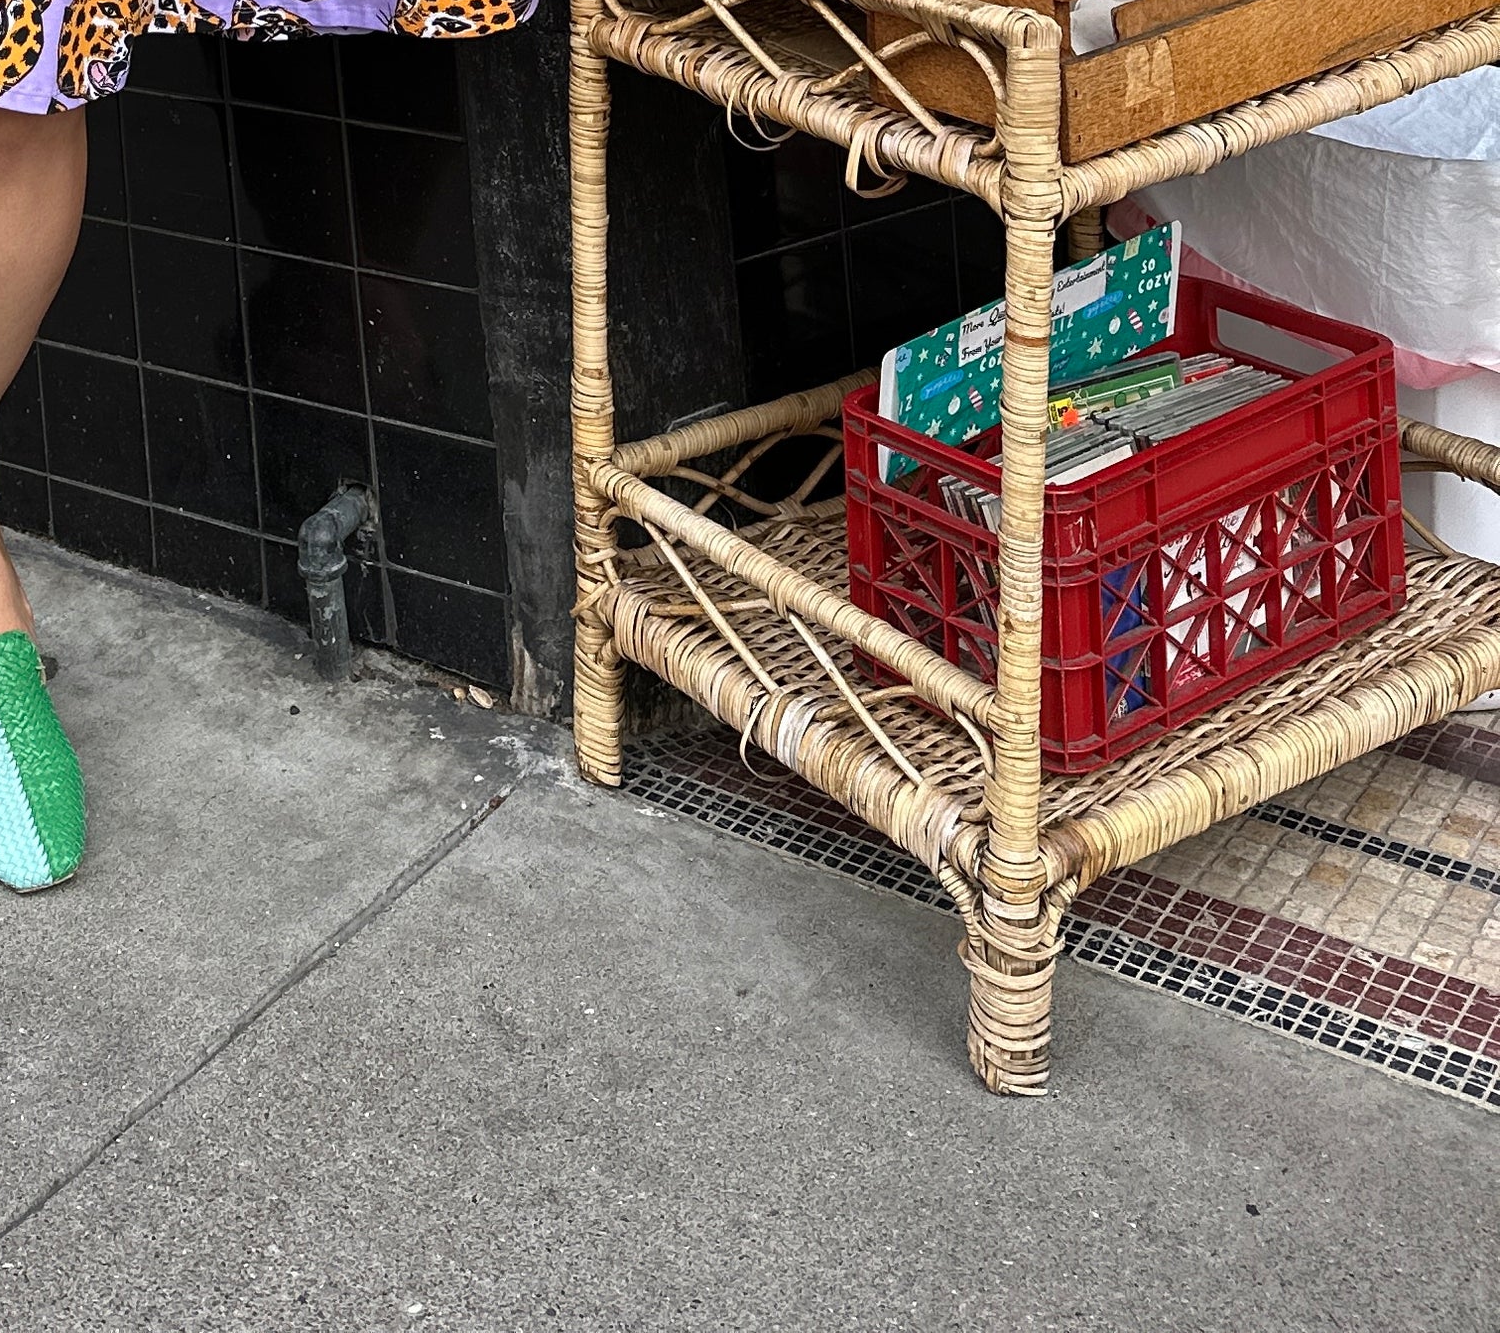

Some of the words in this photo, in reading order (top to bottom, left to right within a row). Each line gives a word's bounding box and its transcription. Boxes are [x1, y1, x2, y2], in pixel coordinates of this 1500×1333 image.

[1140, 259, 1156, 275] SO
[1138, 272, 1172, 294] COZY
[961, 318, 986, 337] More
